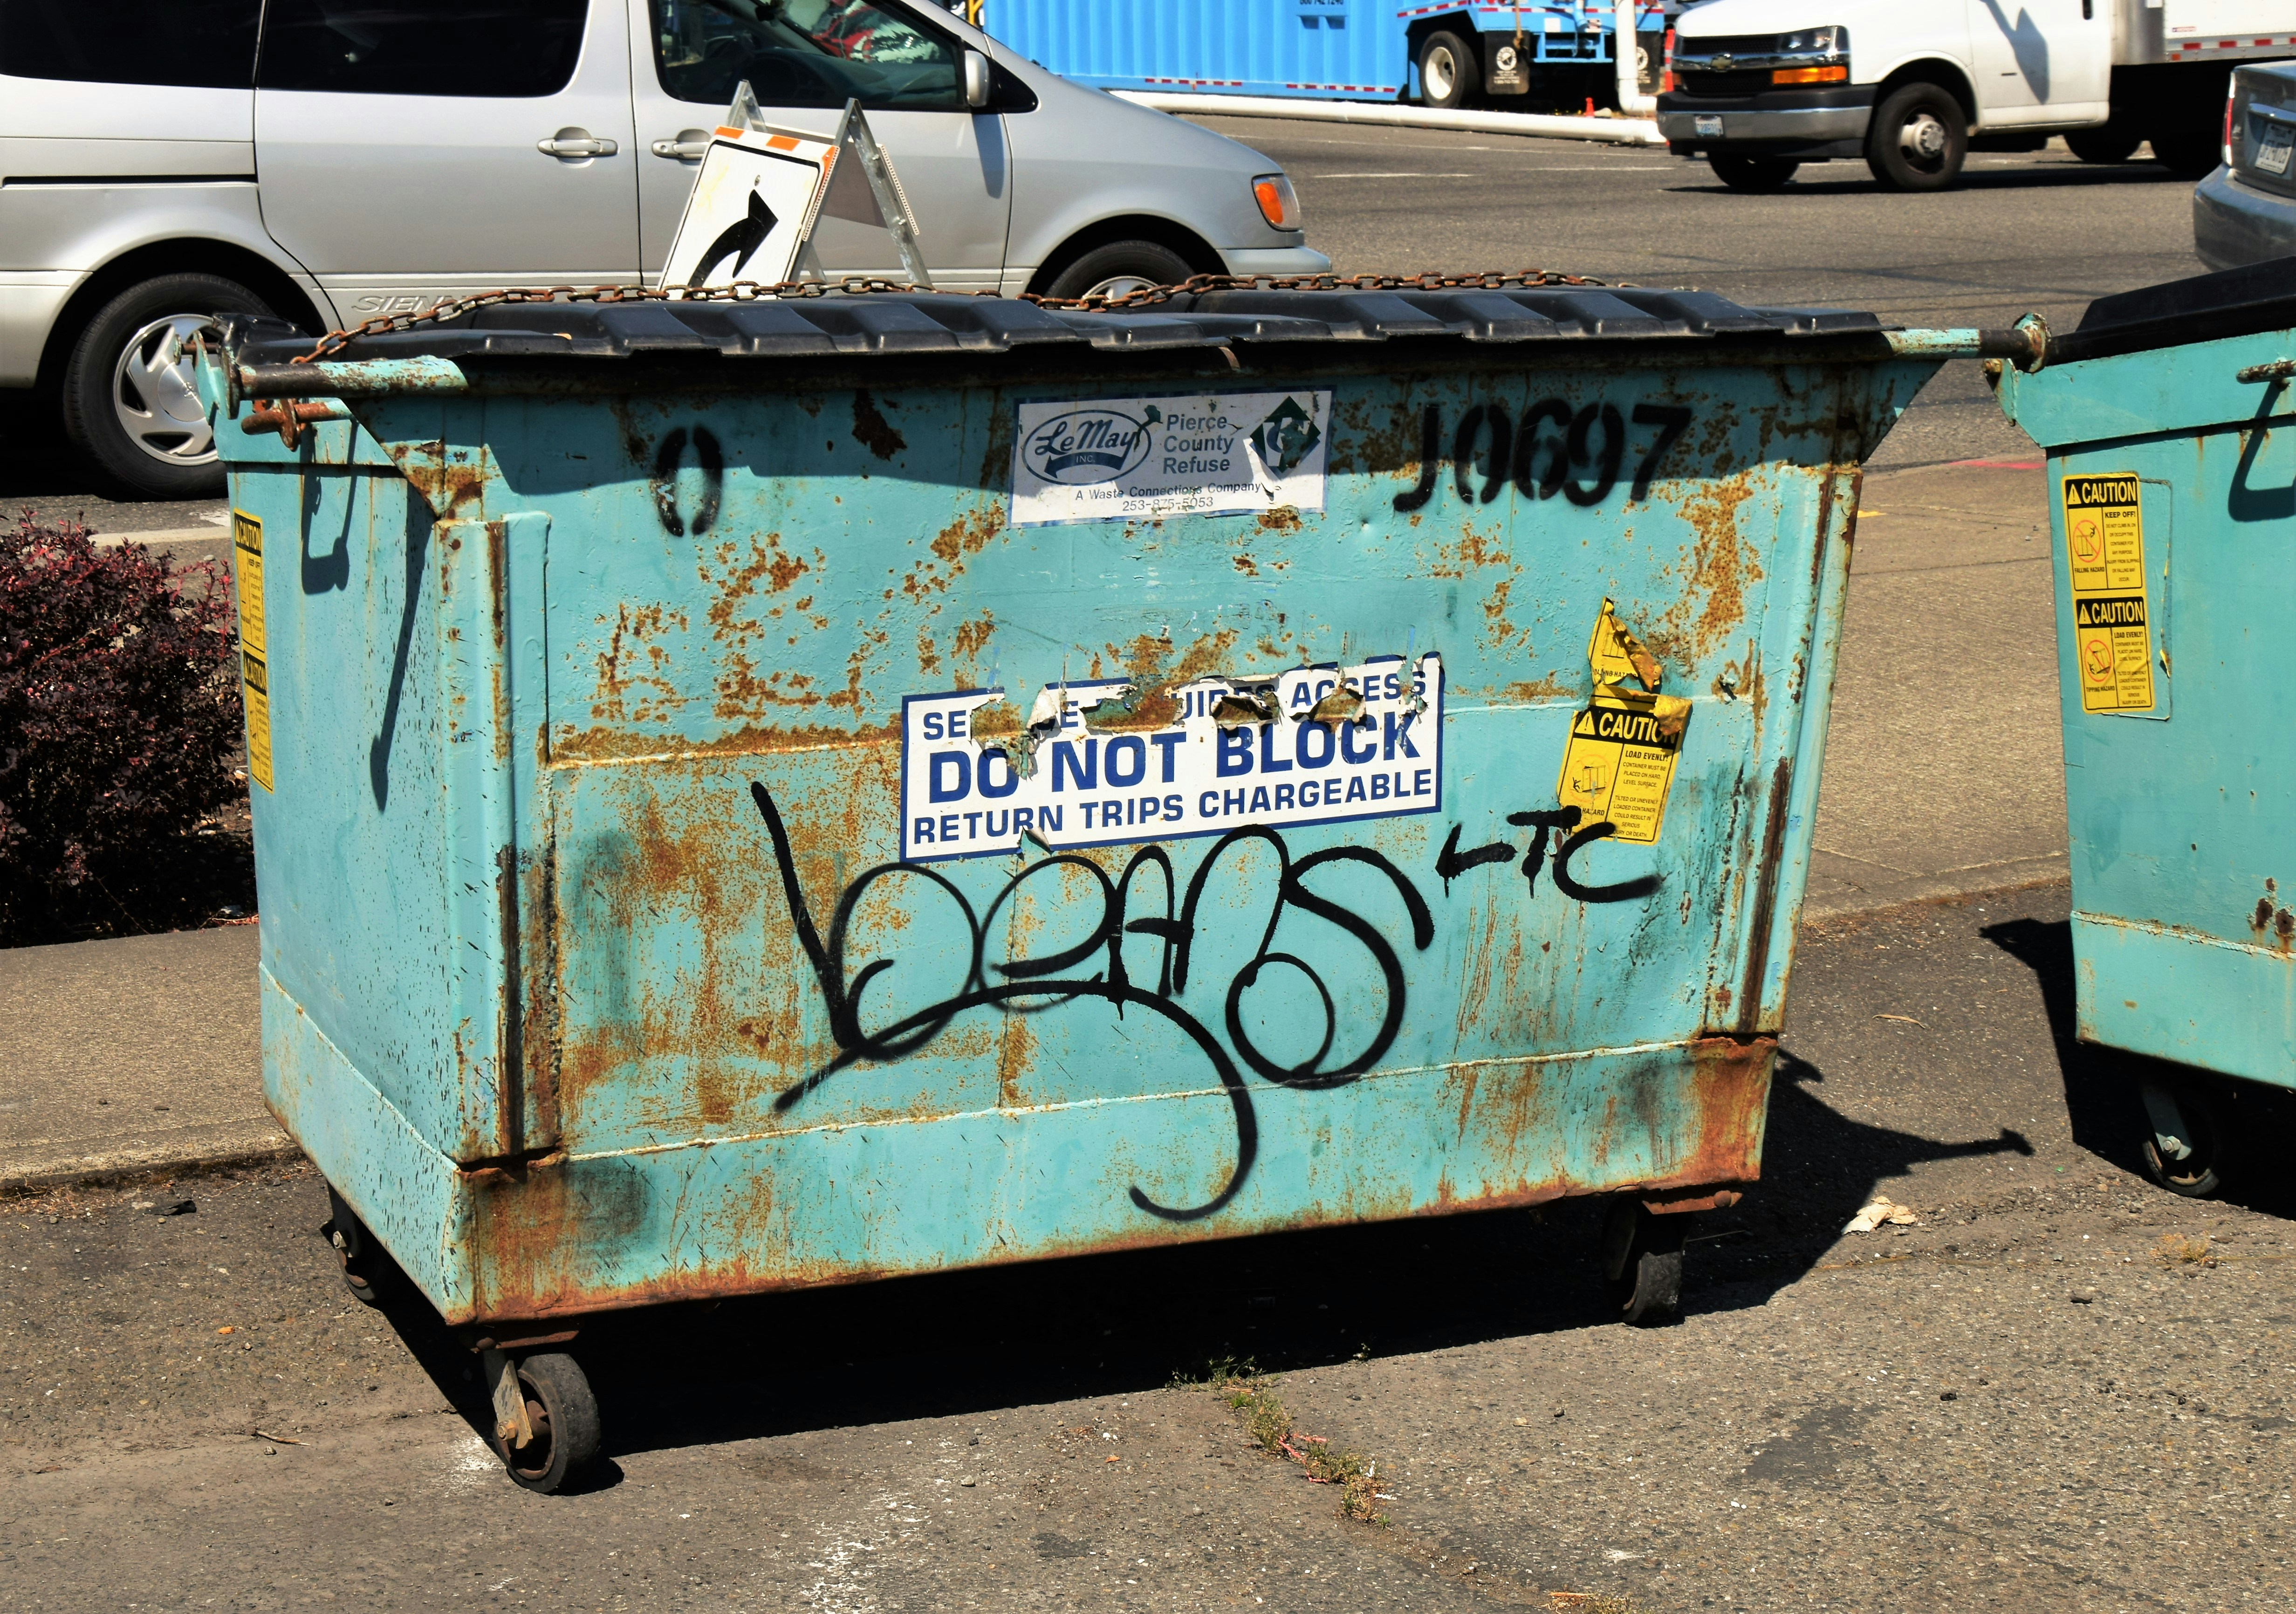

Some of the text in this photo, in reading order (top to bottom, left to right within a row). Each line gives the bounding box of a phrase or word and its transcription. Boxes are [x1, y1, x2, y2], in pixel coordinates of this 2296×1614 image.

[1166, 414, 1227, 431] Pierce
[1164, 434, 1234, 454] County
[1163, 456, 1230, 474] Refuse
[1075, 482, 1261, 500] A Waste Connections Company
[2082, 481, 2137, 504] CAUTION
[240, 520, 261, 552] CAUTION
[2091, 601, 2144, 624] CAUTION
[929, 709, 1421, 803] DO NOT BLOCK
[1625, 750, 1668, 762] LOAD EVENLY!
[914, 769, 1431, 845] RETURN TRIPS CHARGEABLE
